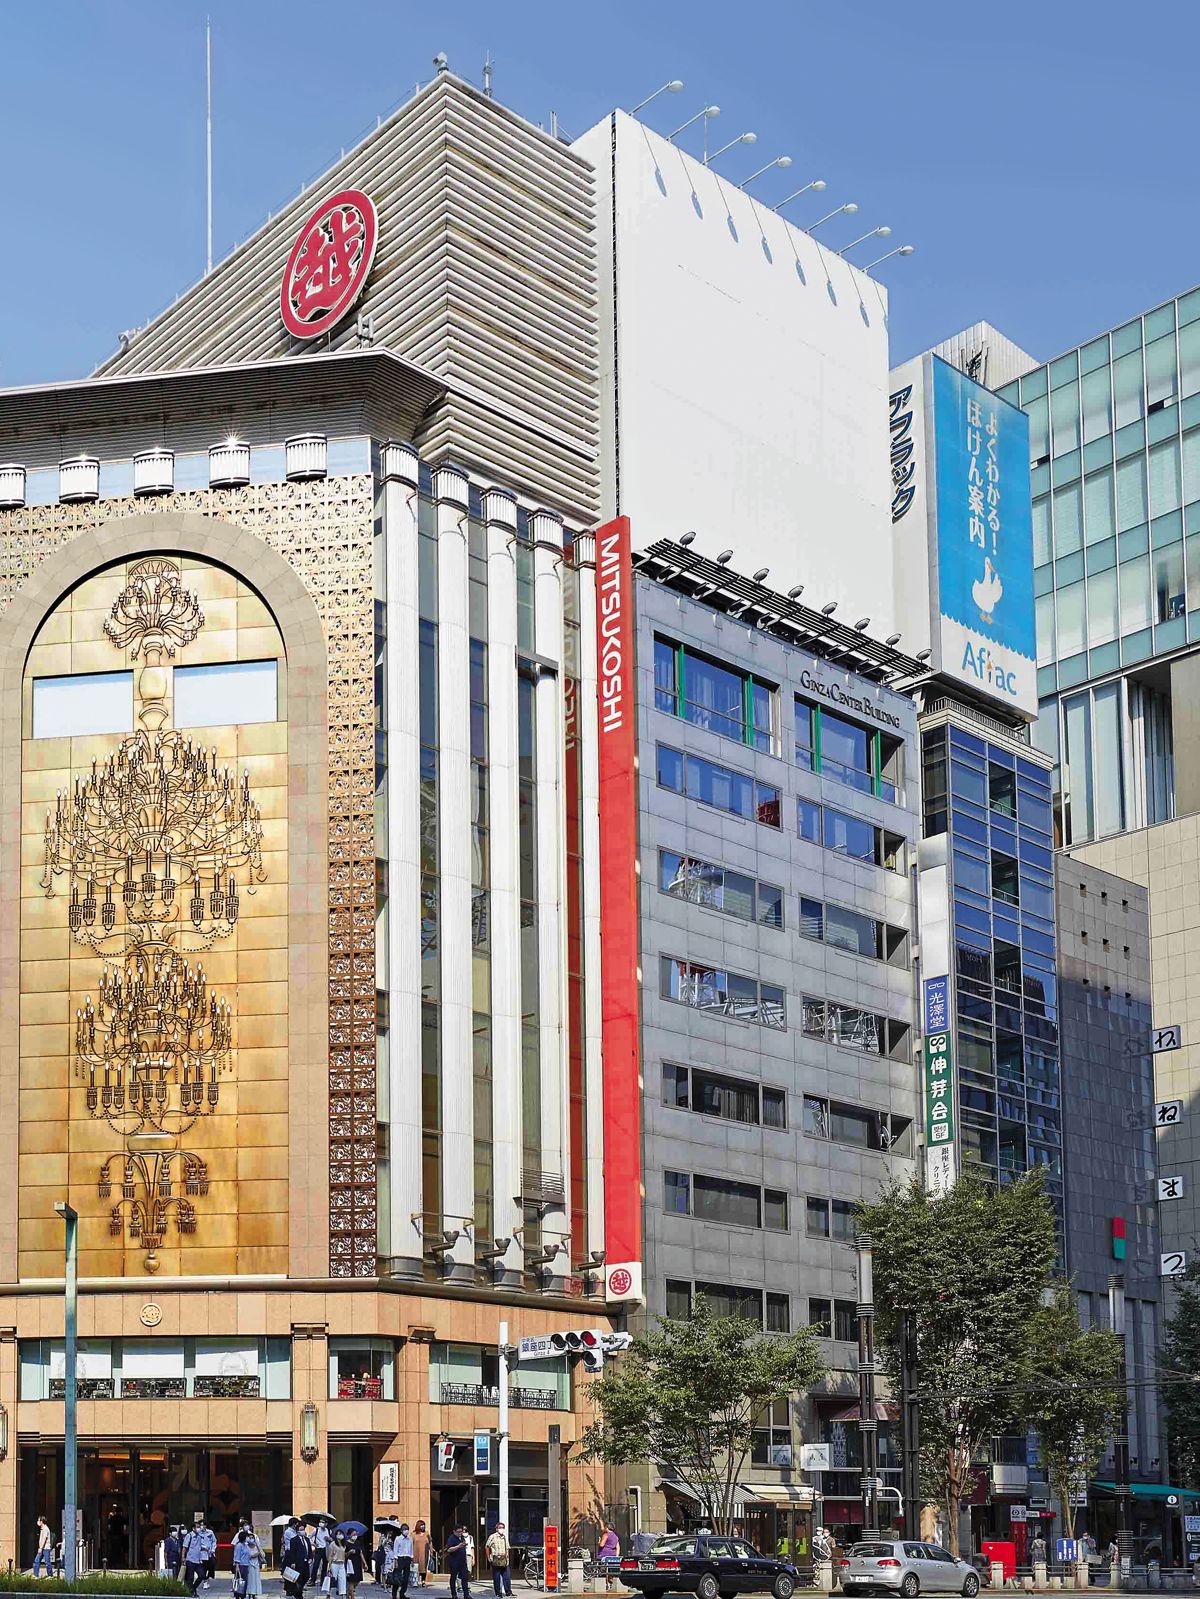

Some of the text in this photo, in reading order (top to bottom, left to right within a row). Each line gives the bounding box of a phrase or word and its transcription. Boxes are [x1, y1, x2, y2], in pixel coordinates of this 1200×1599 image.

[889, 384, 916, 518] アフラック
[967, 397, 985, 549] ほけん案内
[601, 533, 623, 733] MITSUKOSHI
[929, 992, 945, 1029] 光澤堂
[930, 1057, 948, 1121] 伸芽会
